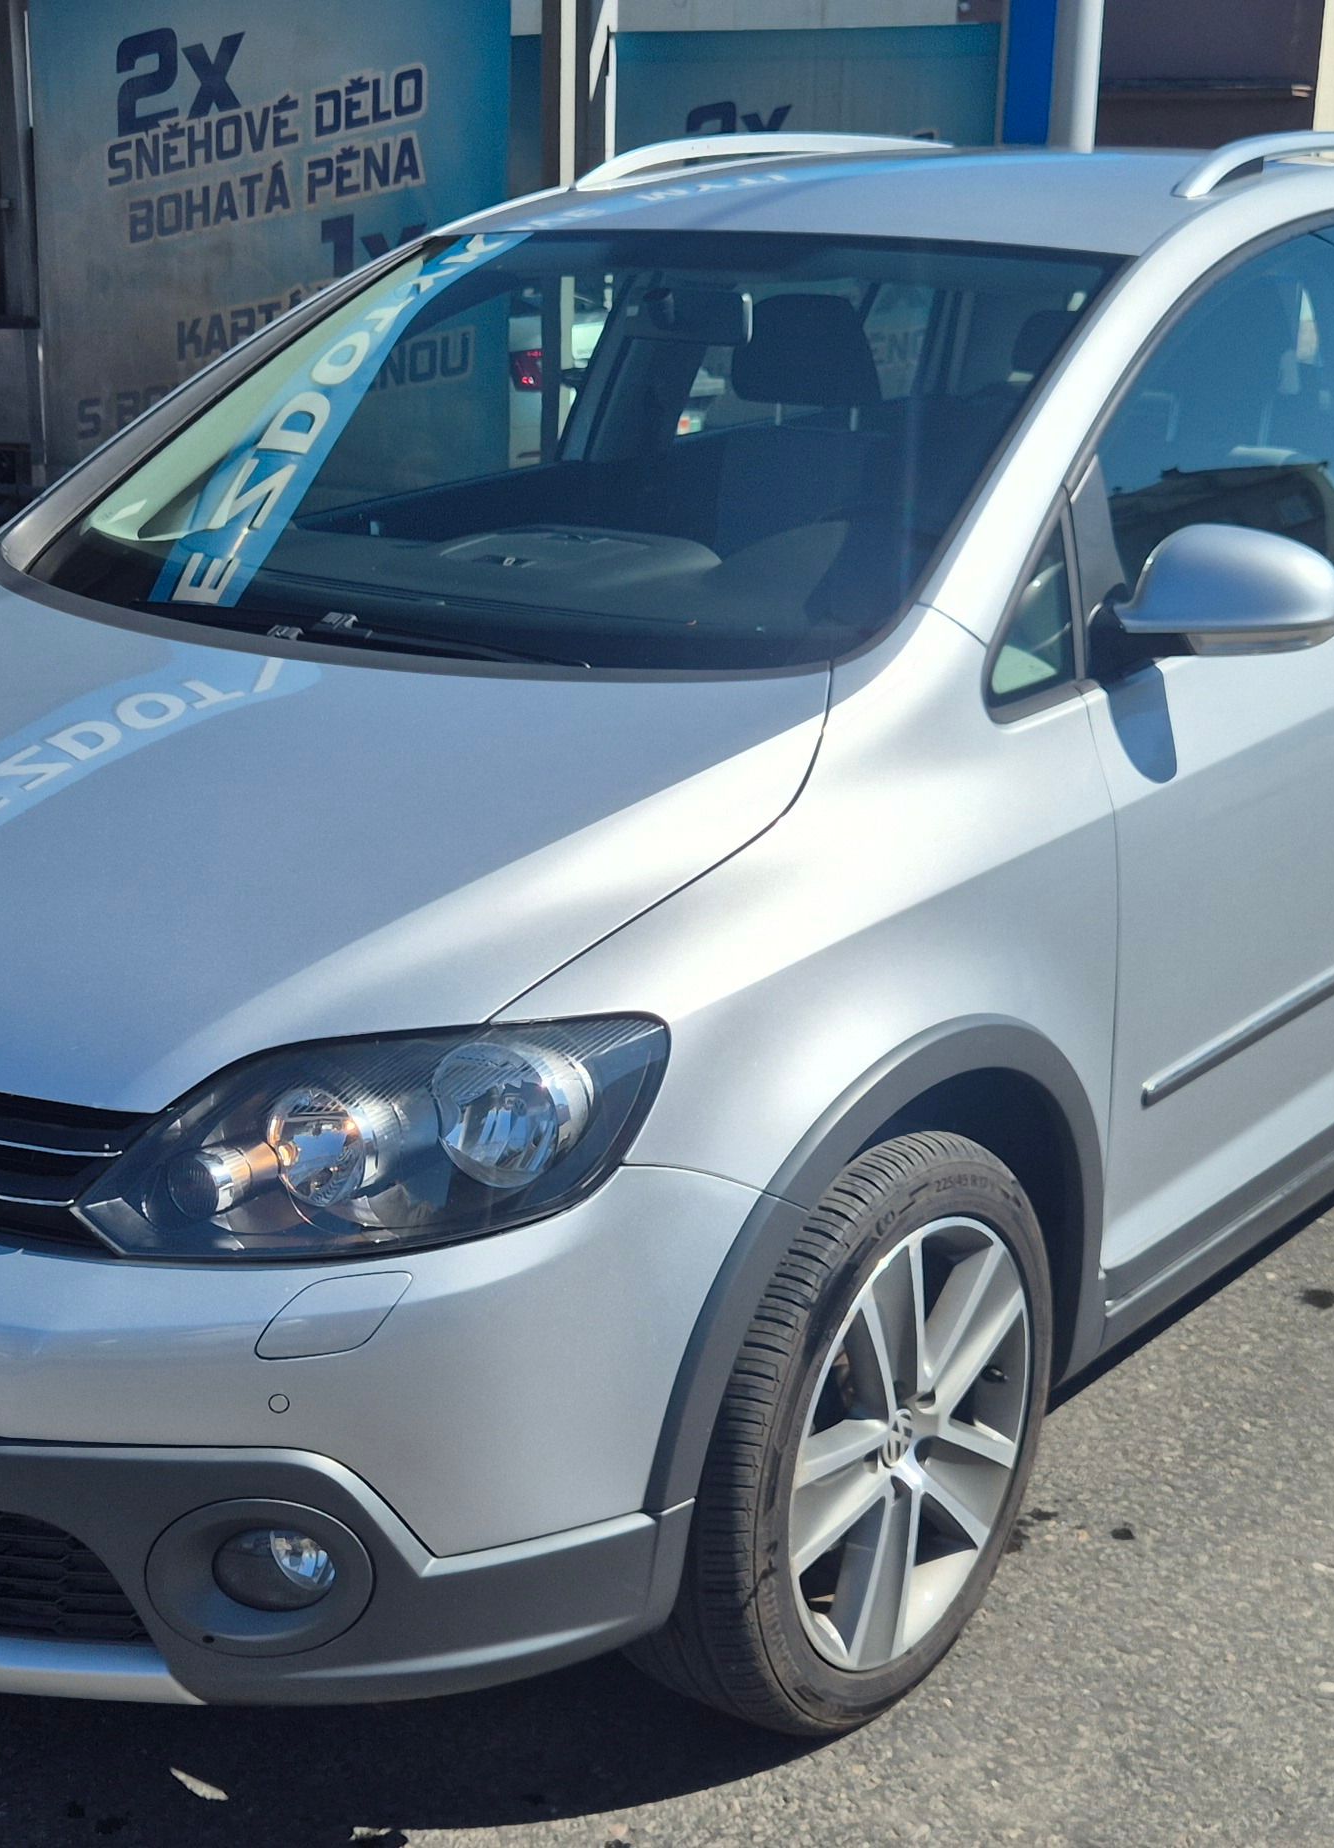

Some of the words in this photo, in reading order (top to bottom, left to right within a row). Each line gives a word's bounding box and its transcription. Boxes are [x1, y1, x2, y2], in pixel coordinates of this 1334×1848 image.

[108, 93, 299, 187] SNĚHOVÉ
[314, 67, 424, 139] DĚLO
[117, 27, 245, 137] 2x
[129, 160, 290, 244] BOHATÁ
[307, 137, 420, 205] PĚNA
